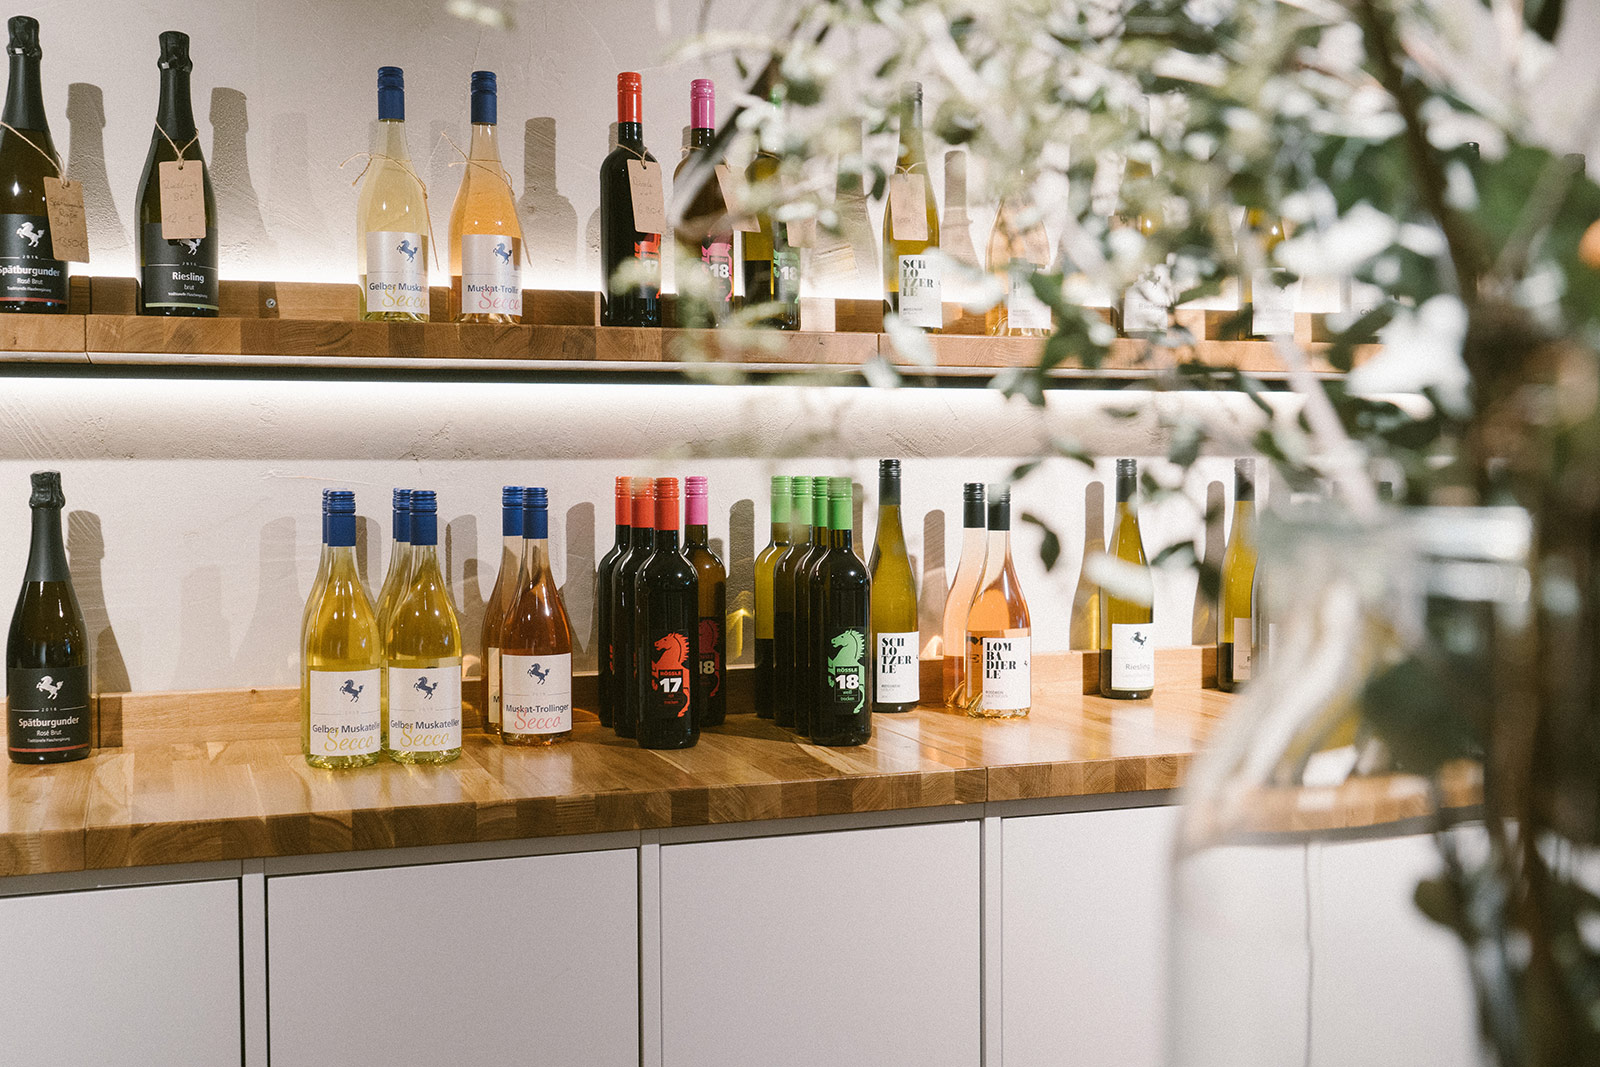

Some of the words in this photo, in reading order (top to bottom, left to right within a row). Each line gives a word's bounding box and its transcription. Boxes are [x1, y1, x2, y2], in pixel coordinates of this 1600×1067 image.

[903, 259, 926, 269] SCH
[710, 263, 729, 278] 18
[780, 266, 798, 280] 18
[903, 269, 919, 278] LO
[172, 271, 205, 284] Riesling
[184, 283, 195, 291] brut
[369, 281, 396, 291] Gelber
[903, 278, 934, 288] TZER
[382, 287, 426, 308] Secco
[903, 288, 918, 297] LE
[881, 638, 905, 647] SCH
[986, 642, 1012, 651] LOM
[881, 647, 898, 656] LO
[986, 652, 1002, 660] BA
[881, 656, 912, 665] TZER
[986, 661, 1016, 670] DIER
[881, 665, 897, 674] LE
[1125, 663, 1151, 672] Riesling
[986, 670, 1001, 679] LE
[660, 677, 682, 693] 17
[835, 674, 859, 689] 18
[506, 704, 569, 713] Muskat-Trollinger
[18, 716, 80, 729] Spätburgunder
[390, 719, 413, 729] Gelber
[415, 718, 460, 730] Muskateller
[514, 709, 561, 730] Secco
[36, 729, 50, 737] Rosé
[312, 724, 339, 734] Gelber
[324, 730, 373, 752] Secco
[400, 725, 450, 748] Secco
